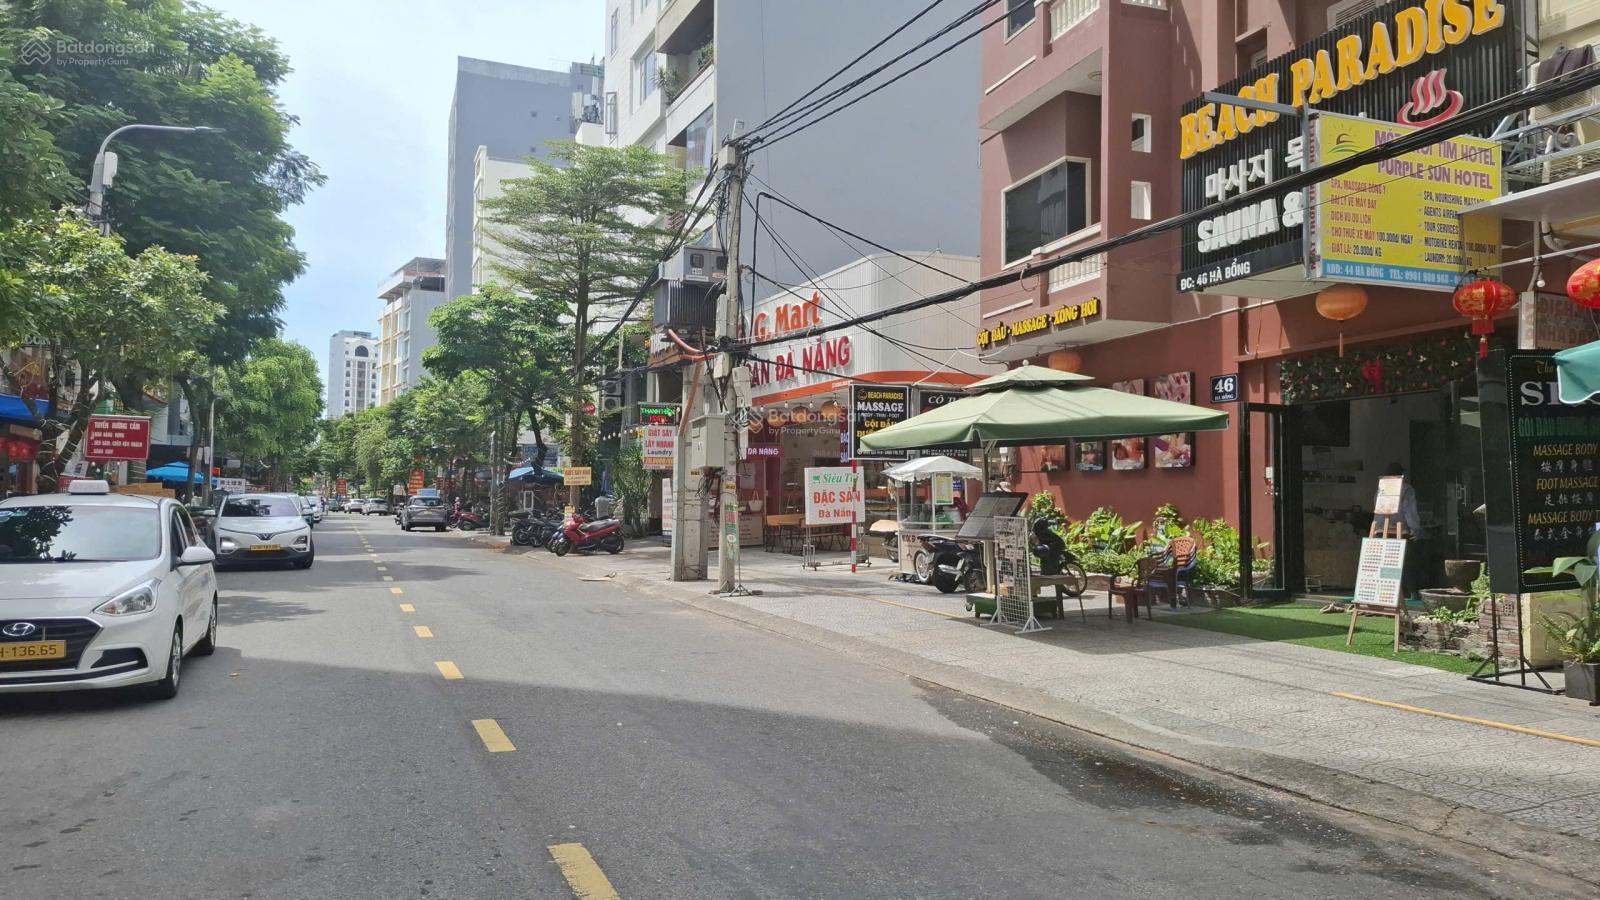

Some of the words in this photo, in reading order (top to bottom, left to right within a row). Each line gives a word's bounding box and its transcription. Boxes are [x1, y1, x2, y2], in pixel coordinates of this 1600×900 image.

[1180, 73, 1279, 159] BEACH
[1291, 0, 1505, 108] PARADISE
[1461, 143, 1496, 166] HOTEL
[1205, 149, 1273, 201] 마사지
[1377, 159, 1424, 179] PURPLE
[1427, 165, 1451, 184] SUN
[1455, 169, 1493, 189] HOTEL
[1198, 198, 1280, 253] SAUNA
[1210, 266, 1222, 282] HÀ
[1225, 258, 1250, 279] BỔNG
[1011, 314, 1047, 336] MASSAGE
[1214, 377, 1234, 393] 46
[857, 401, 904, 413] MASSAGE
[1533, 444, 1573, 456] MASSAGE
[1575, 443, 1598, 455] BODY
[1536, 478, 1560, 490] FOOT
[1561, 476, 1599, 488] MASSAGE
[1528, 513, 1568, 525] MASSAGE
[1570, 511, 1593, 522] BODY
